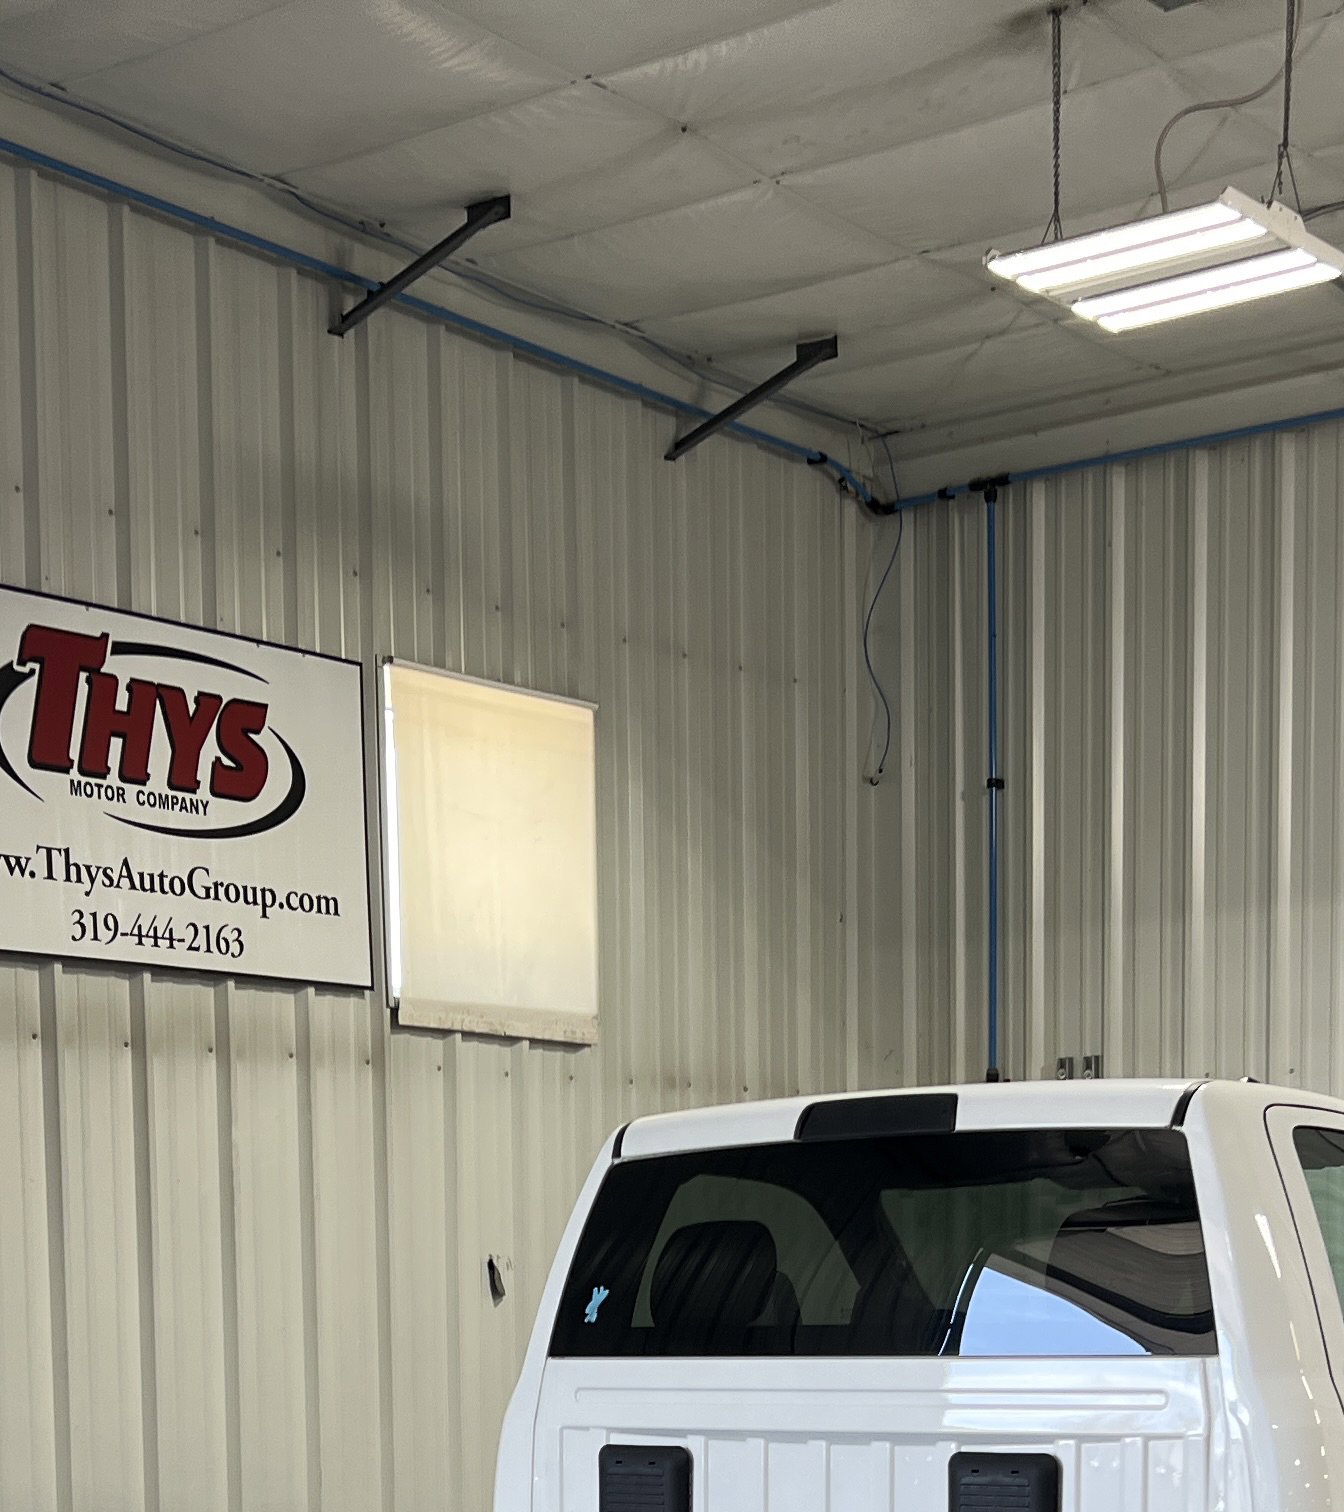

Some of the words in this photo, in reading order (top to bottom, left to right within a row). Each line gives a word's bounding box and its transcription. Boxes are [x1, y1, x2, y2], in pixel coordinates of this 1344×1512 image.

[16, 623, 270, 803] THYS
[69, 779, 127, 804] MOTOR
[136, 790, 210, 816] COMPANY
[70, 908, 246, 959] 319-444-2163
